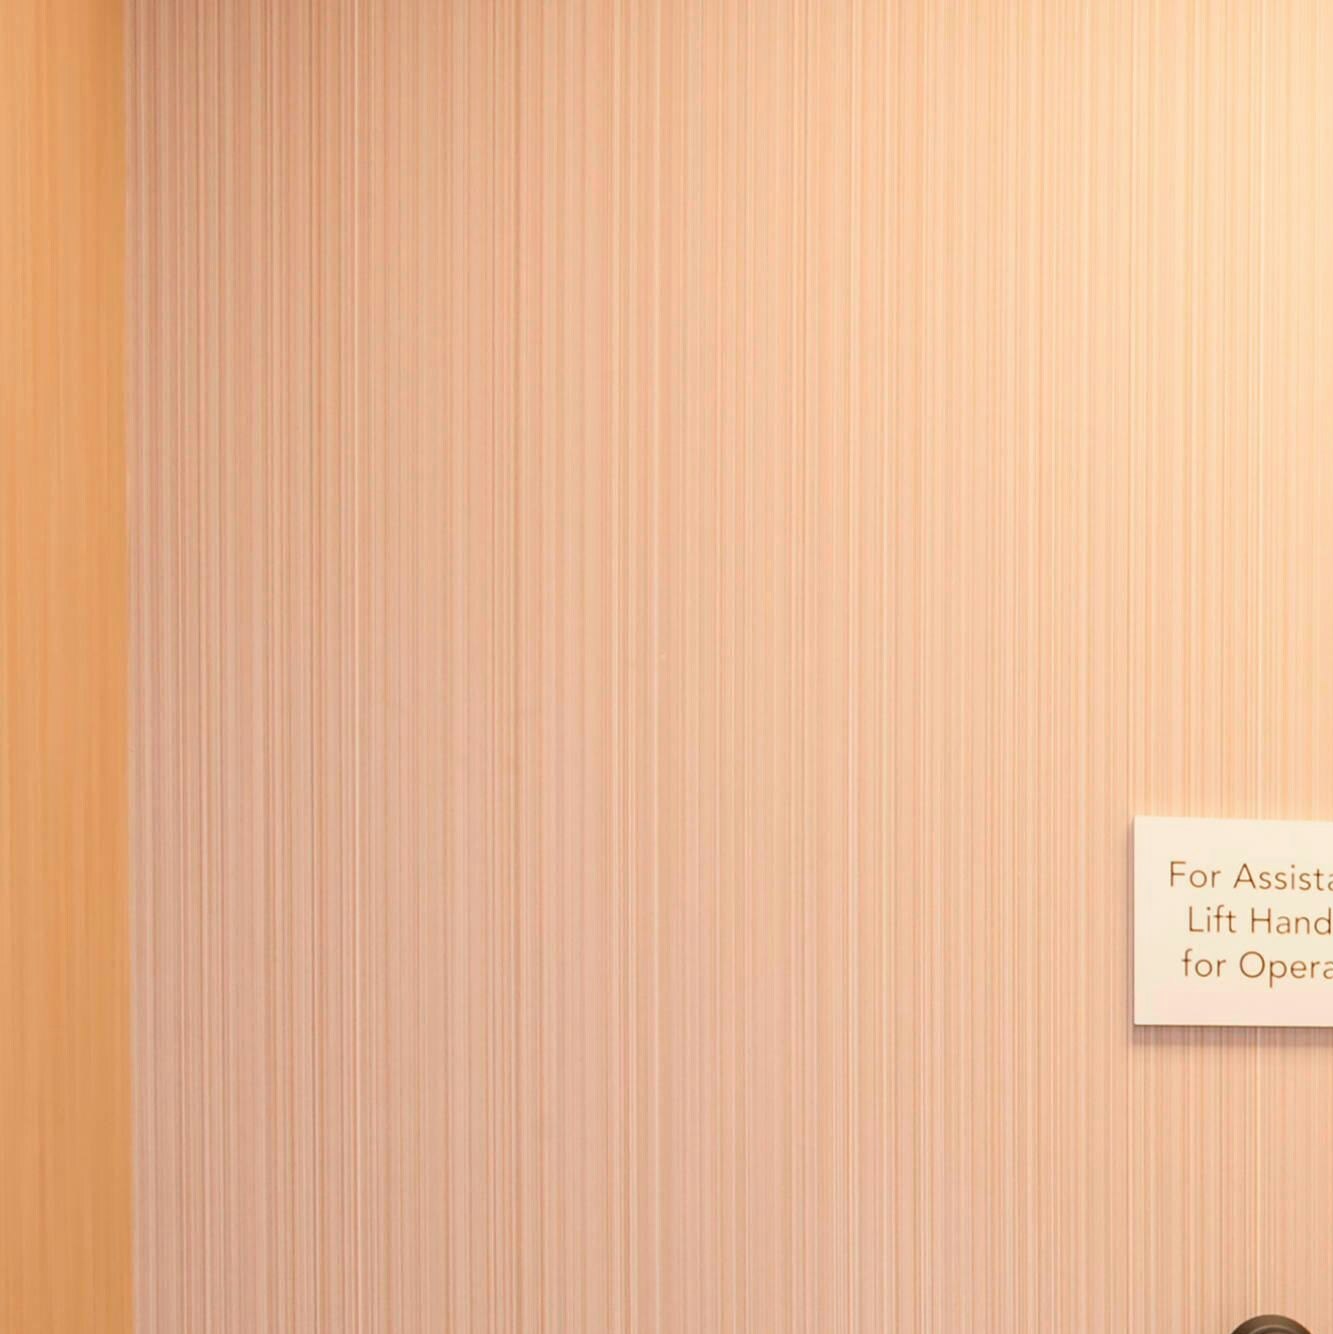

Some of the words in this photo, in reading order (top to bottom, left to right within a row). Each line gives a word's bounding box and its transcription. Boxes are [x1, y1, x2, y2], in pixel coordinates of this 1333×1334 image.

[1170, 861, 1221, 888] For
[1188, 904, 1237, 934] Lift
[1181, 948, 1227, 978] for
